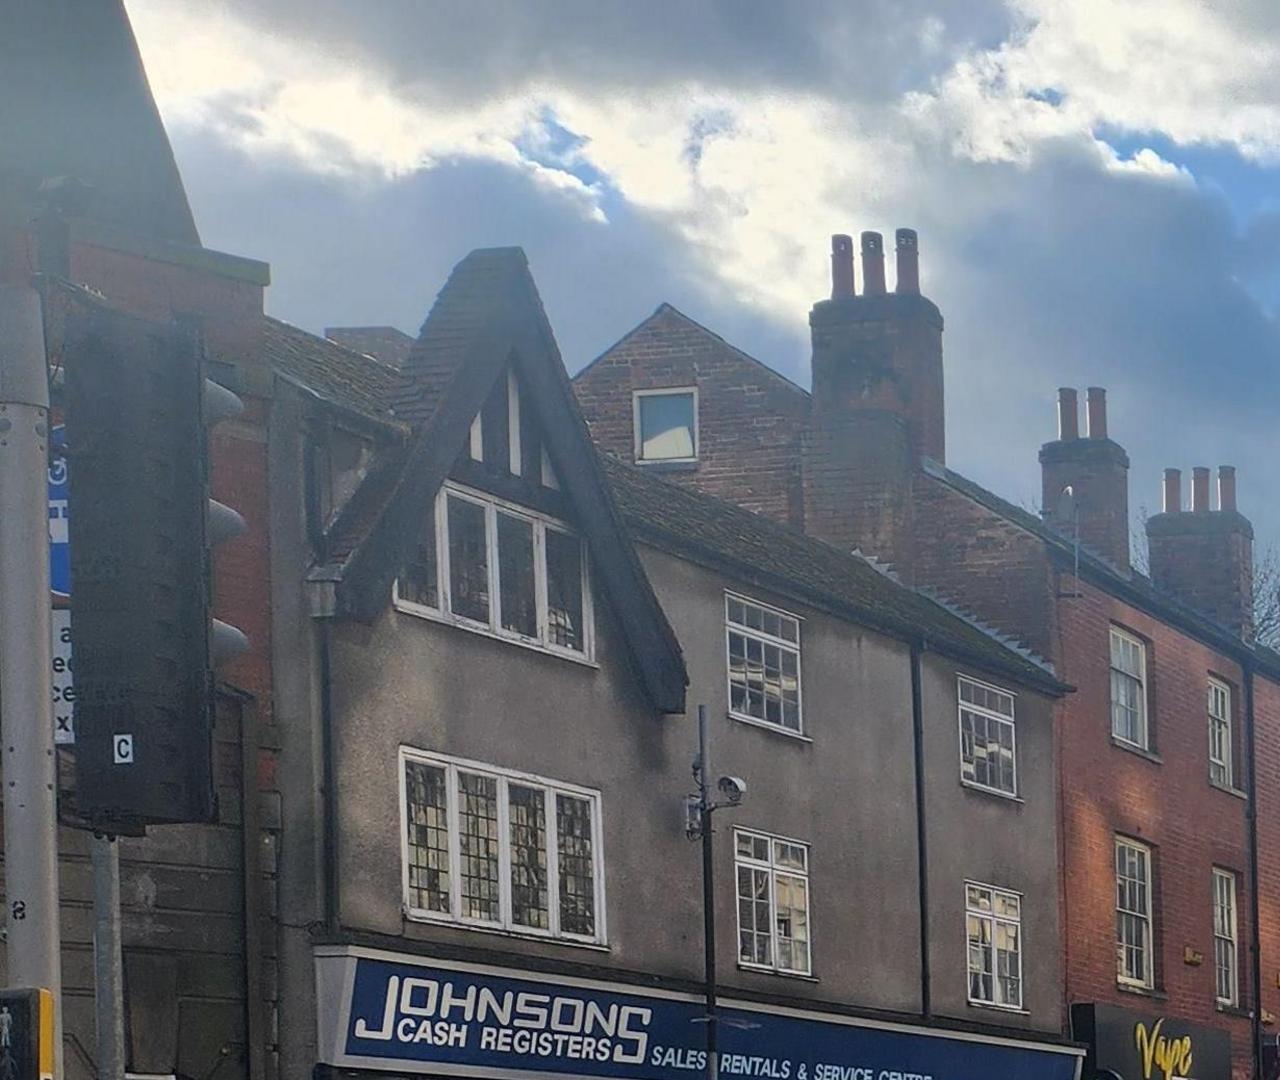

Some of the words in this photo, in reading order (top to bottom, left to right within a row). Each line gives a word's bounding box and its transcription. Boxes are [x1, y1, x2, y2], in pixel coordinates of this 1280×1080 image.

[117, 739, 130, 758] C
[355, 975, 652, 1064] JOHNSONS
[397, 1018, 468, 1047] CASH
[481, 1027, 611, 1061] REGISTERS
[651, 1046, 707, 1070] SALES
[720, 1054, 791, 1080] RENTALS
[797, 1062, 808, 1080] &
